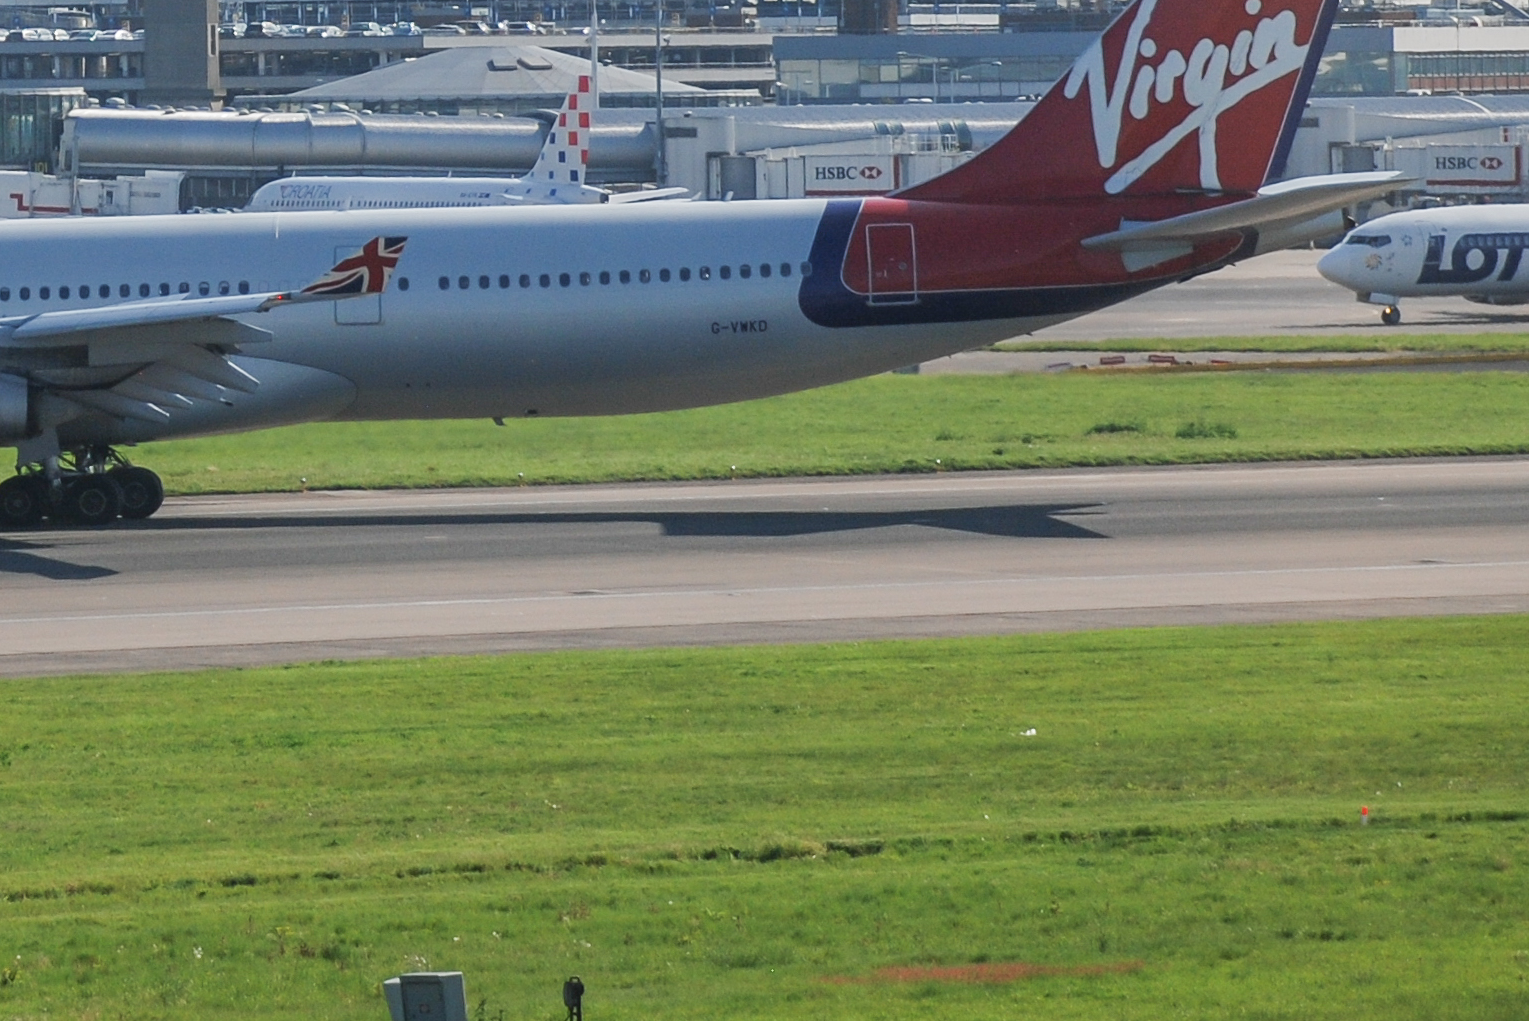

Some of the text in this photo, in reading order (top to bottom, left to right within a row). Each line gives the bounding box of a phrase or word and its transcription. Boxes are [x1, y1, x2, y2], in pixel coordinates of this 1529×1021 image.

[1435, 156, 1478, 170] HSBC
[815, 166, 858, 180] HSBC
[280, 184, 332, 199] CROATIA
[1416, 232, 1529, 284] LOT
[711, 320, 768, 334] G-VWKD
